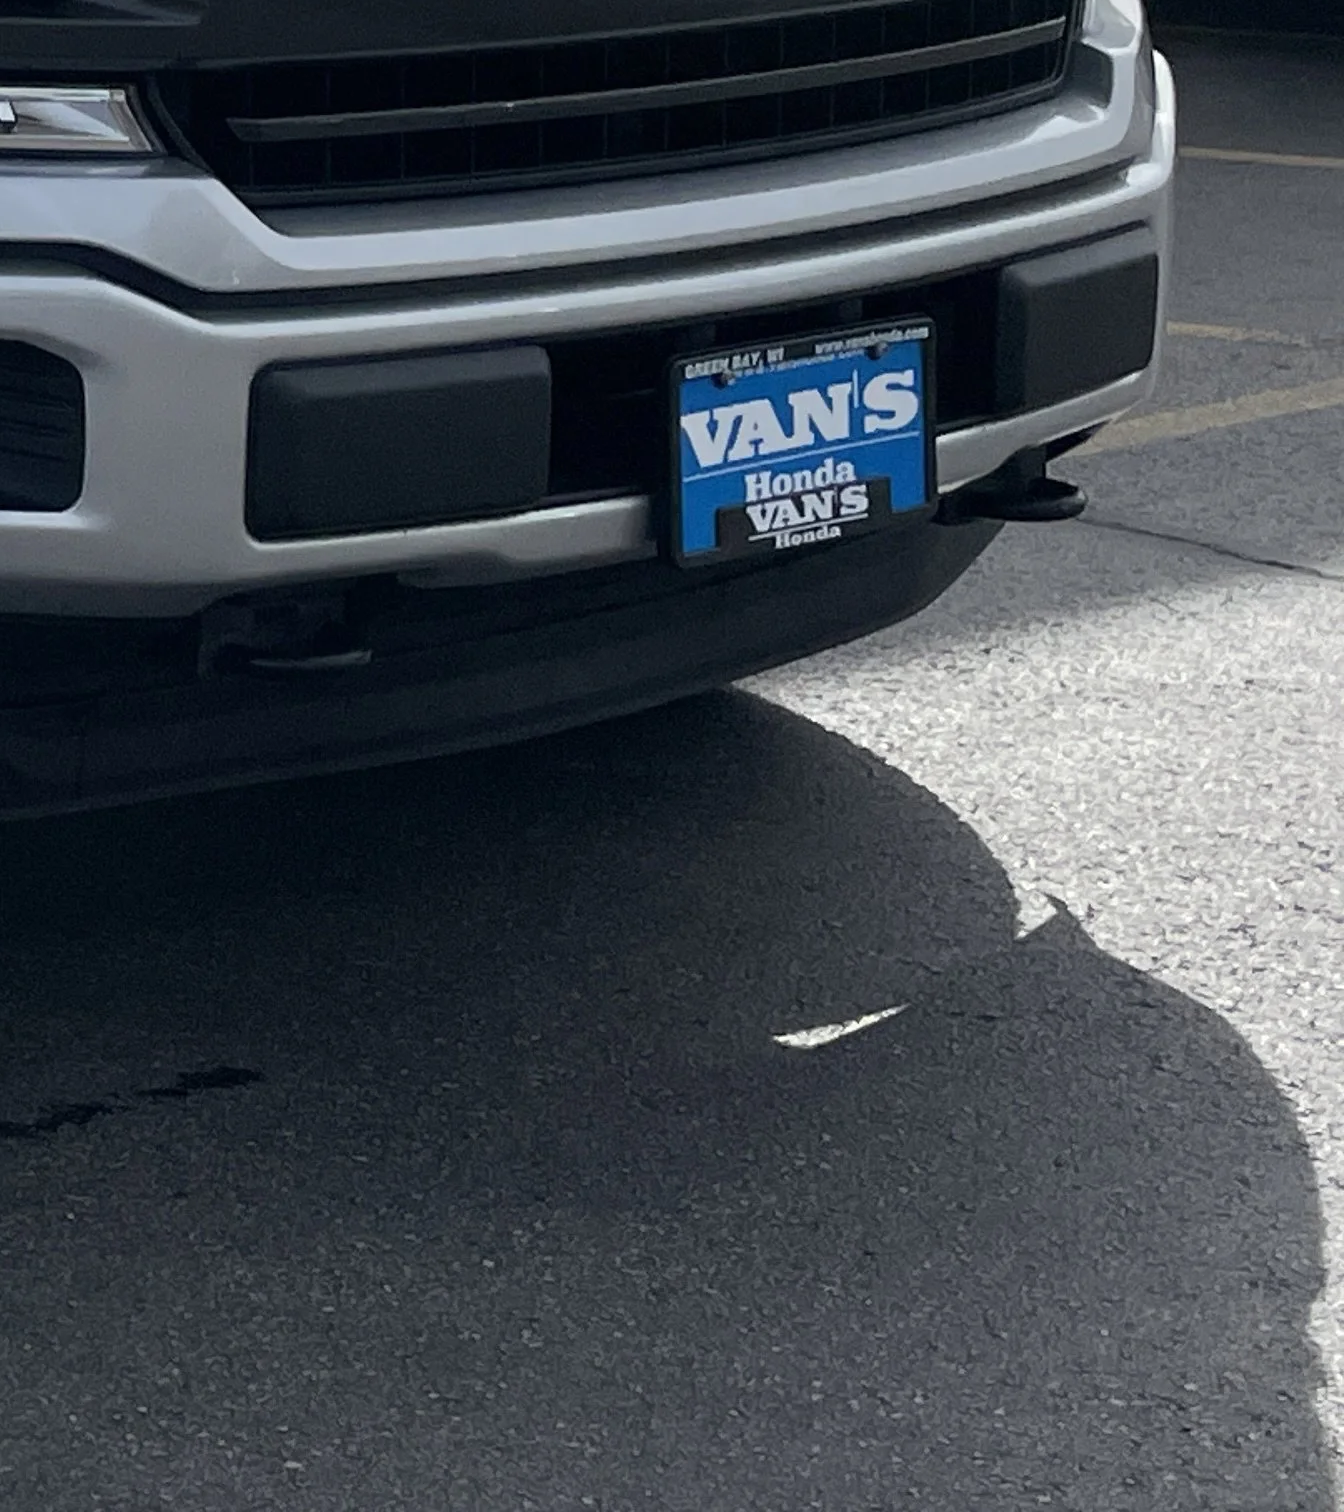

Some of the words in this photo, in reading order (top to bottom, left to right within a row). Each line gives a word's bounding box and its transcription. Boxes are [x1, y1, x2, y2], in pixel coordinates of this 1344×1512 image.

[679, 368, 920, 469] VAN'S
[744, 457, 857, 504] Honda
[746, 484, 869, 533] VAN'S
[774, 523, 842, 550] Honda
